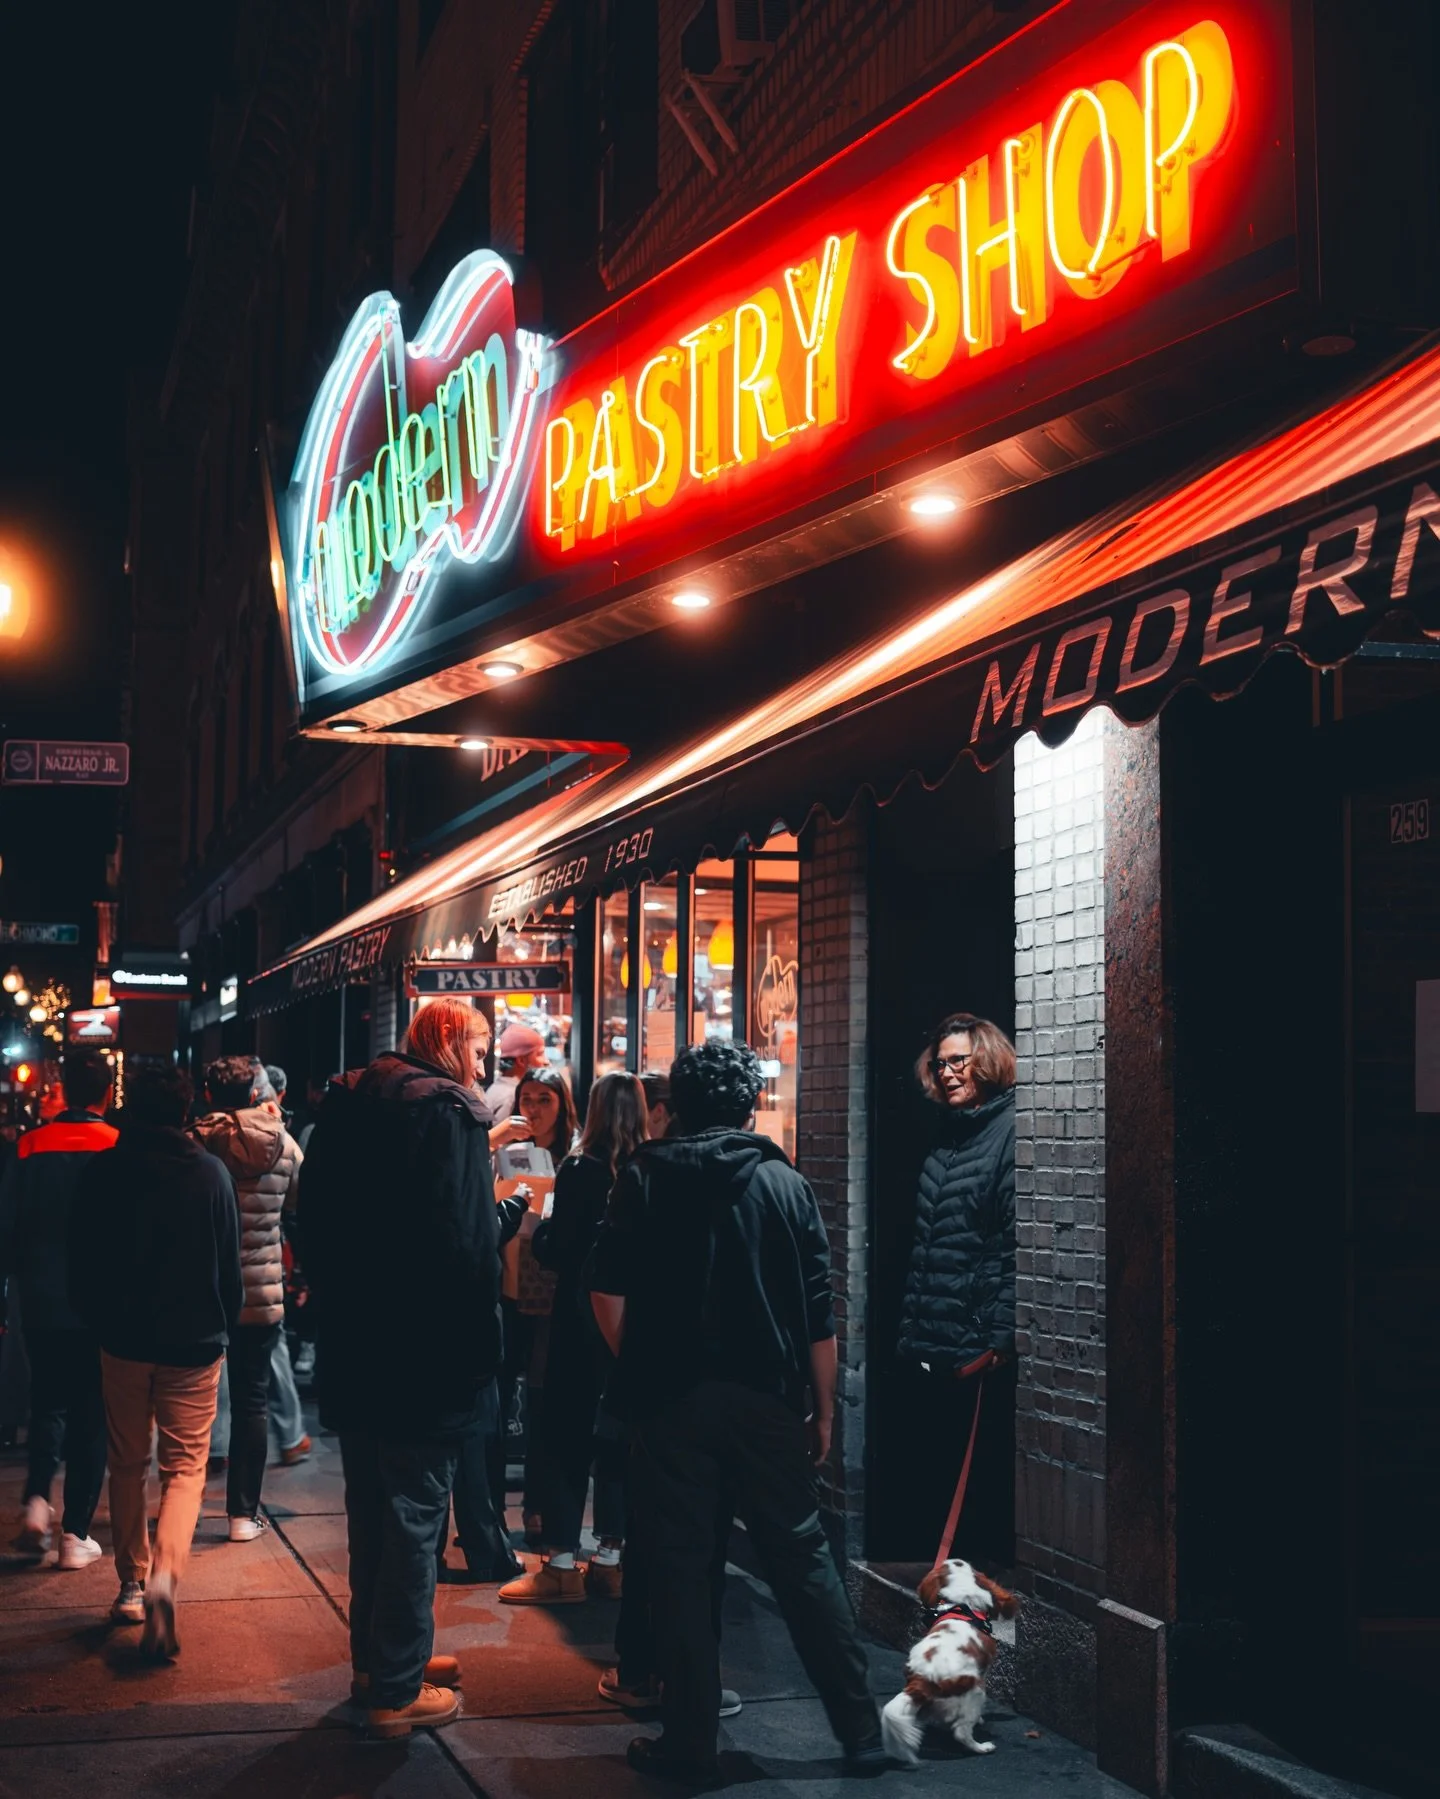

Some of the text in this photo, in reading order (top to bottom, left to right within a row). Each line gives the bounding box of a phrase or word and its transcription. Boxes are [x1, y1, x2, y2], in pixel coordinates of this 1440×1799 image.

[545, 20, 1233, 552] PASTRY SHOP
[314, 303, 512, 634] modern
[45, 756, 119, 772] NAZZARO JR.
[1390, 801, 1428, 842] 259
[488, 827, 655, 918] ESTABLISHED 1930
[338, 925, 392, 974] PASTRY
[437, 970, 540, 990] PASTRY
